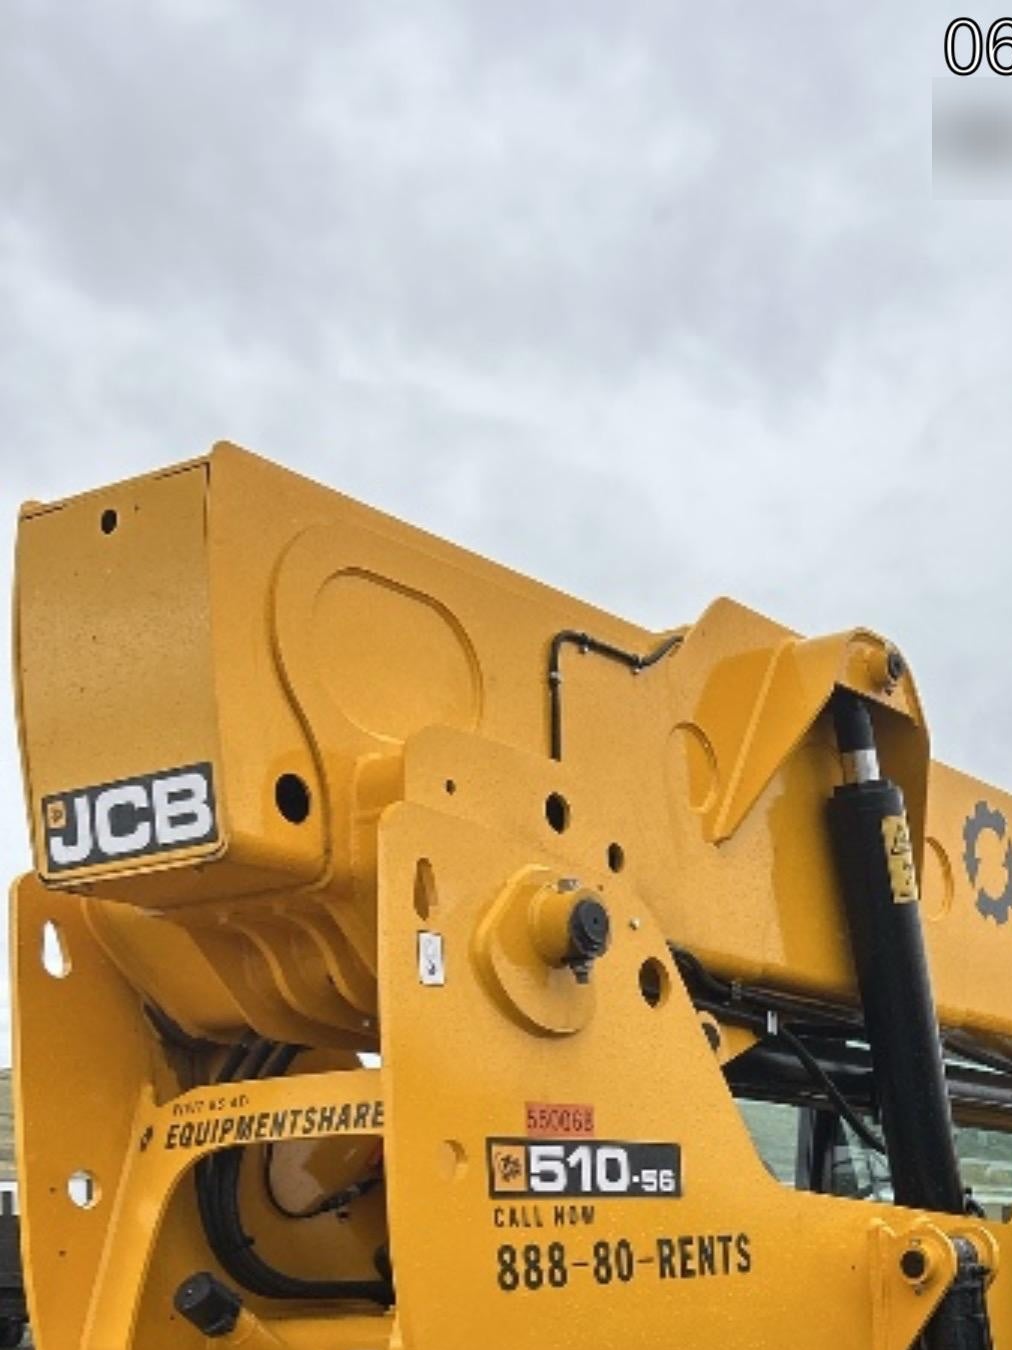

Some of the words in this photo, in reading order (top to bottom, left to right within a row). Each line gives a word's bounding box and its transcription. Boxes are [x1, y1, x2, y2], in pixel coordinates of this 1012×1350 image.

[50, 773, 213, 865] JCB
[494, 1206, 544, 1228] CALL
[497, 1233, 752, 1292] 888-80-RENTS
